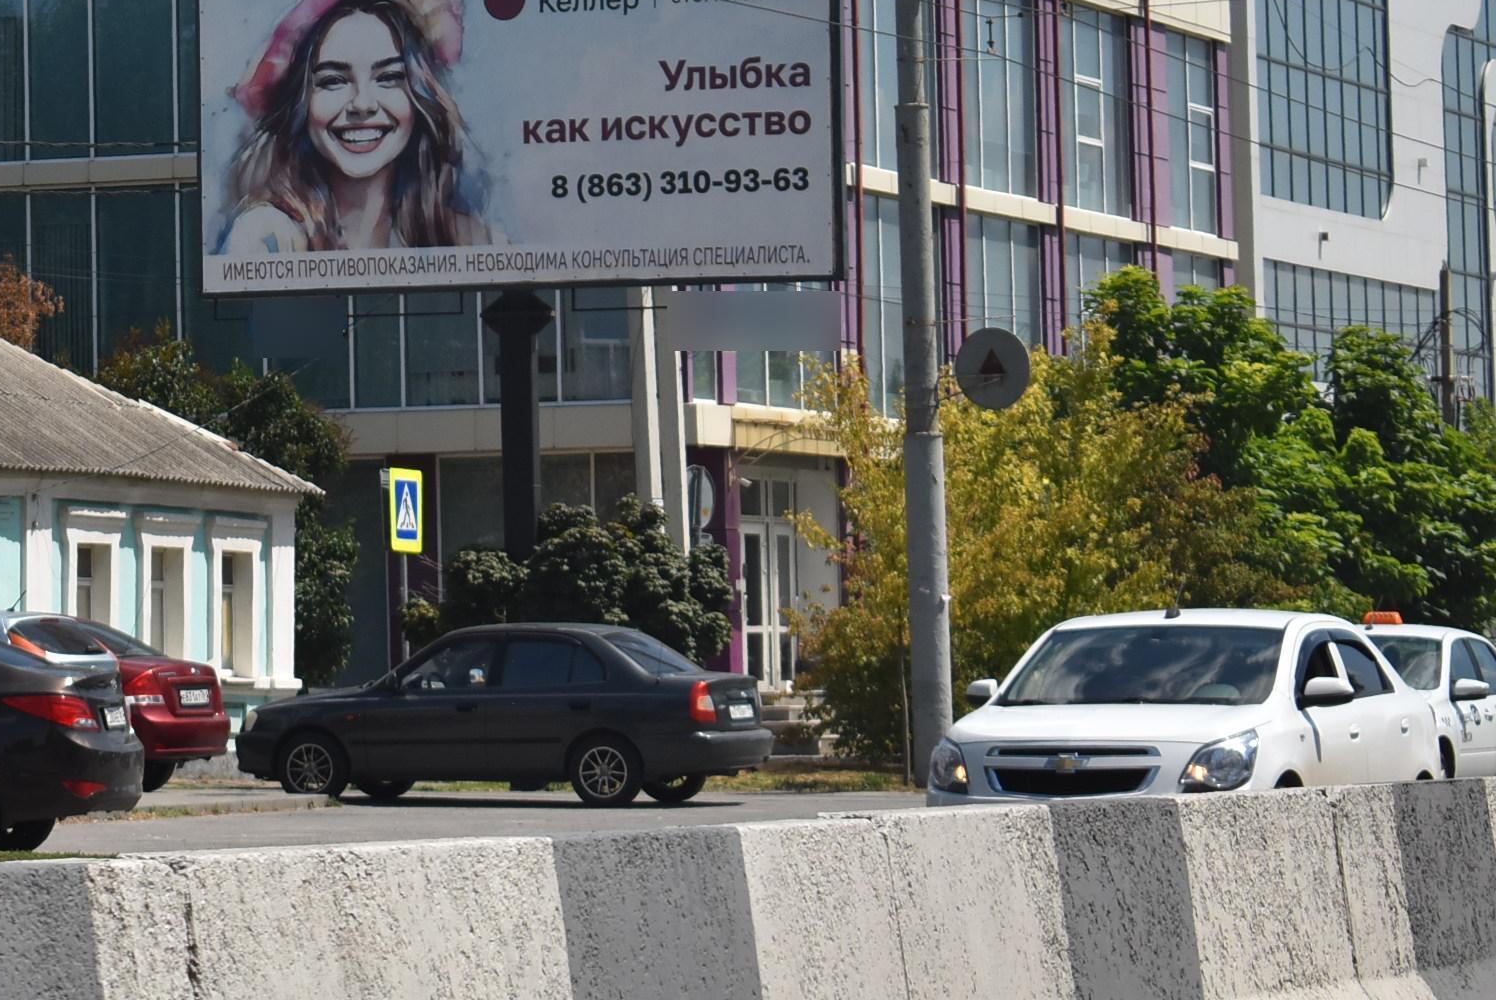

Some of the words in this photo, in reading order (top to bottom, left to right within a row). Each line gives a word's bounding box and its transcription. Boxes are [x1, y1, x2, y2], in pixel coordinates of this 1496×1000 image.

[658, 55, 812, 92] Улыбка
[522, 118, 590, 144] как
[600, 109, 812, 147] искусство
[551, 175, 569, 199] 8
[576, 172, 653, 204] (863)
[659, 167, 810, 196] 310-93-63
[223, 260, 294, 281] ИМЕЮТСЯ
[298, 253, 462, 278] ПРОТИВОПОКАЗАНИЯ.
[466, 249, 568, 273] НЕОБХОДИМА
[572, 247, 689, 270] КОНСУЛЬТАЦИЯ
[693, 244, 811, 267] СПЕЦИАЛИСТА.
